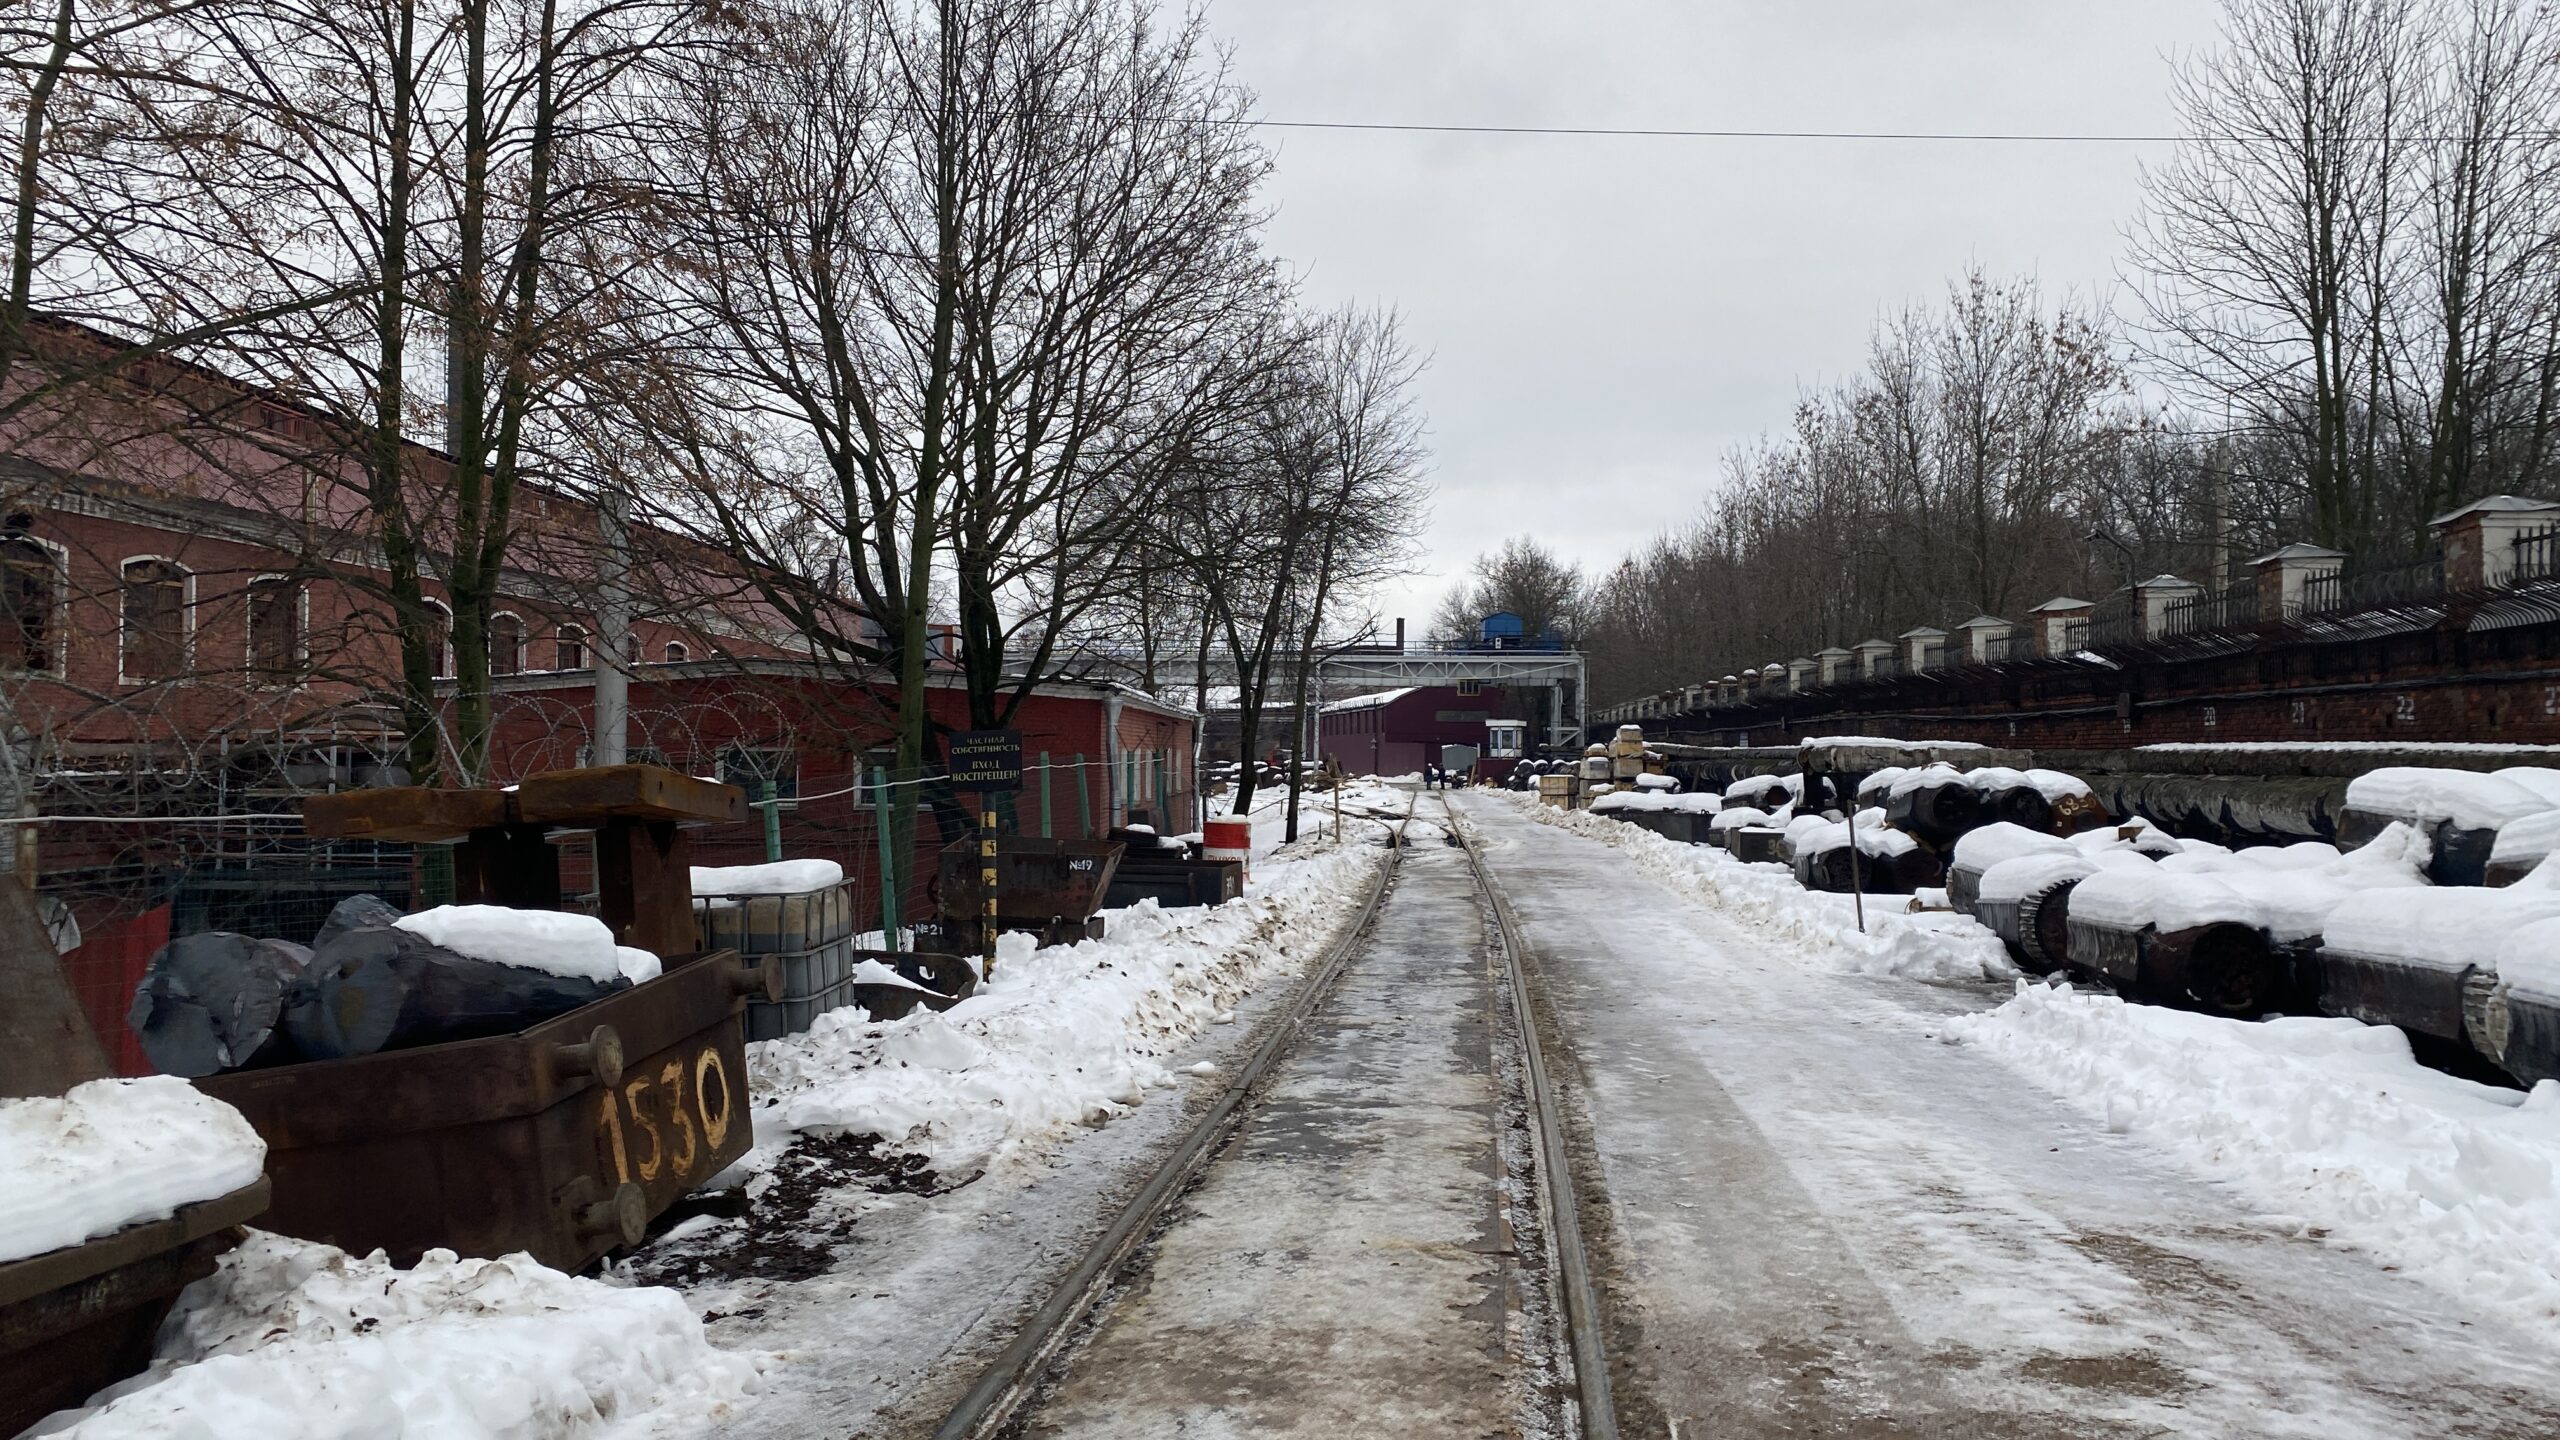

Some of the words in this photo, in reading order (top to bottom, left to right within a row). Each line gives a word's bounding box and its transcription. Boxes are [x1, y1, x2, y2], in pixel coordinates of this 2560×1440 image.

[2397, 695, 2415, 720] 22
[2204, 707, 2216, 726] 20
[951, 744, 1020, 755] СОБСТВЕННОСТЬ
[972, 760, 1000, 770] ВХОД
[1069, 859, 1093, 871] №19
[600, 1047, 730, 1183] 1530
